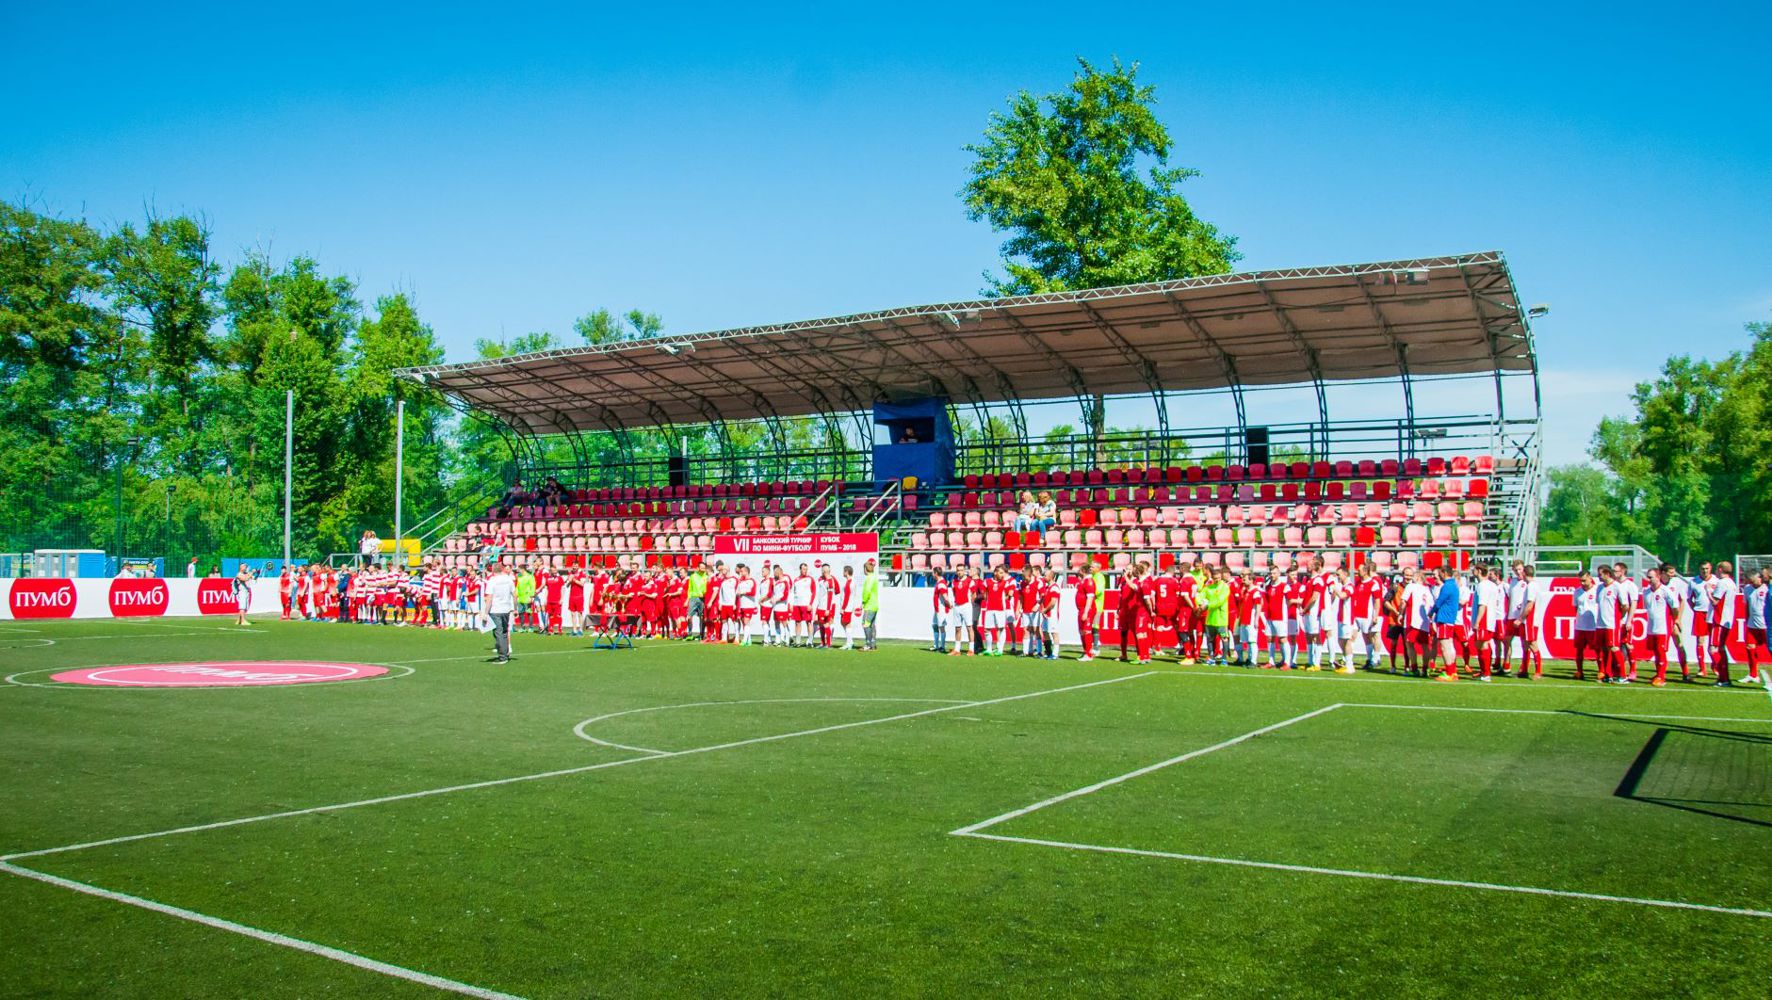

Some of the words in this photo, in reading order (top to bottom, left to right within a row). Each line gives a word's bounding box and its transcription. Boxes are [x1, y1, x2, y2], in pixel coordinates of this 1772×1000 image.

[733, 538, 750, 552] VII
[752, 536, 790, 544] БАНКОВСКИЙ
[763, 544, 812, 552] МИНИ-ФУТБОЛУ
[202, 590, 237, 604] ПУМ
[1160, 584, 1168, 598] 5
